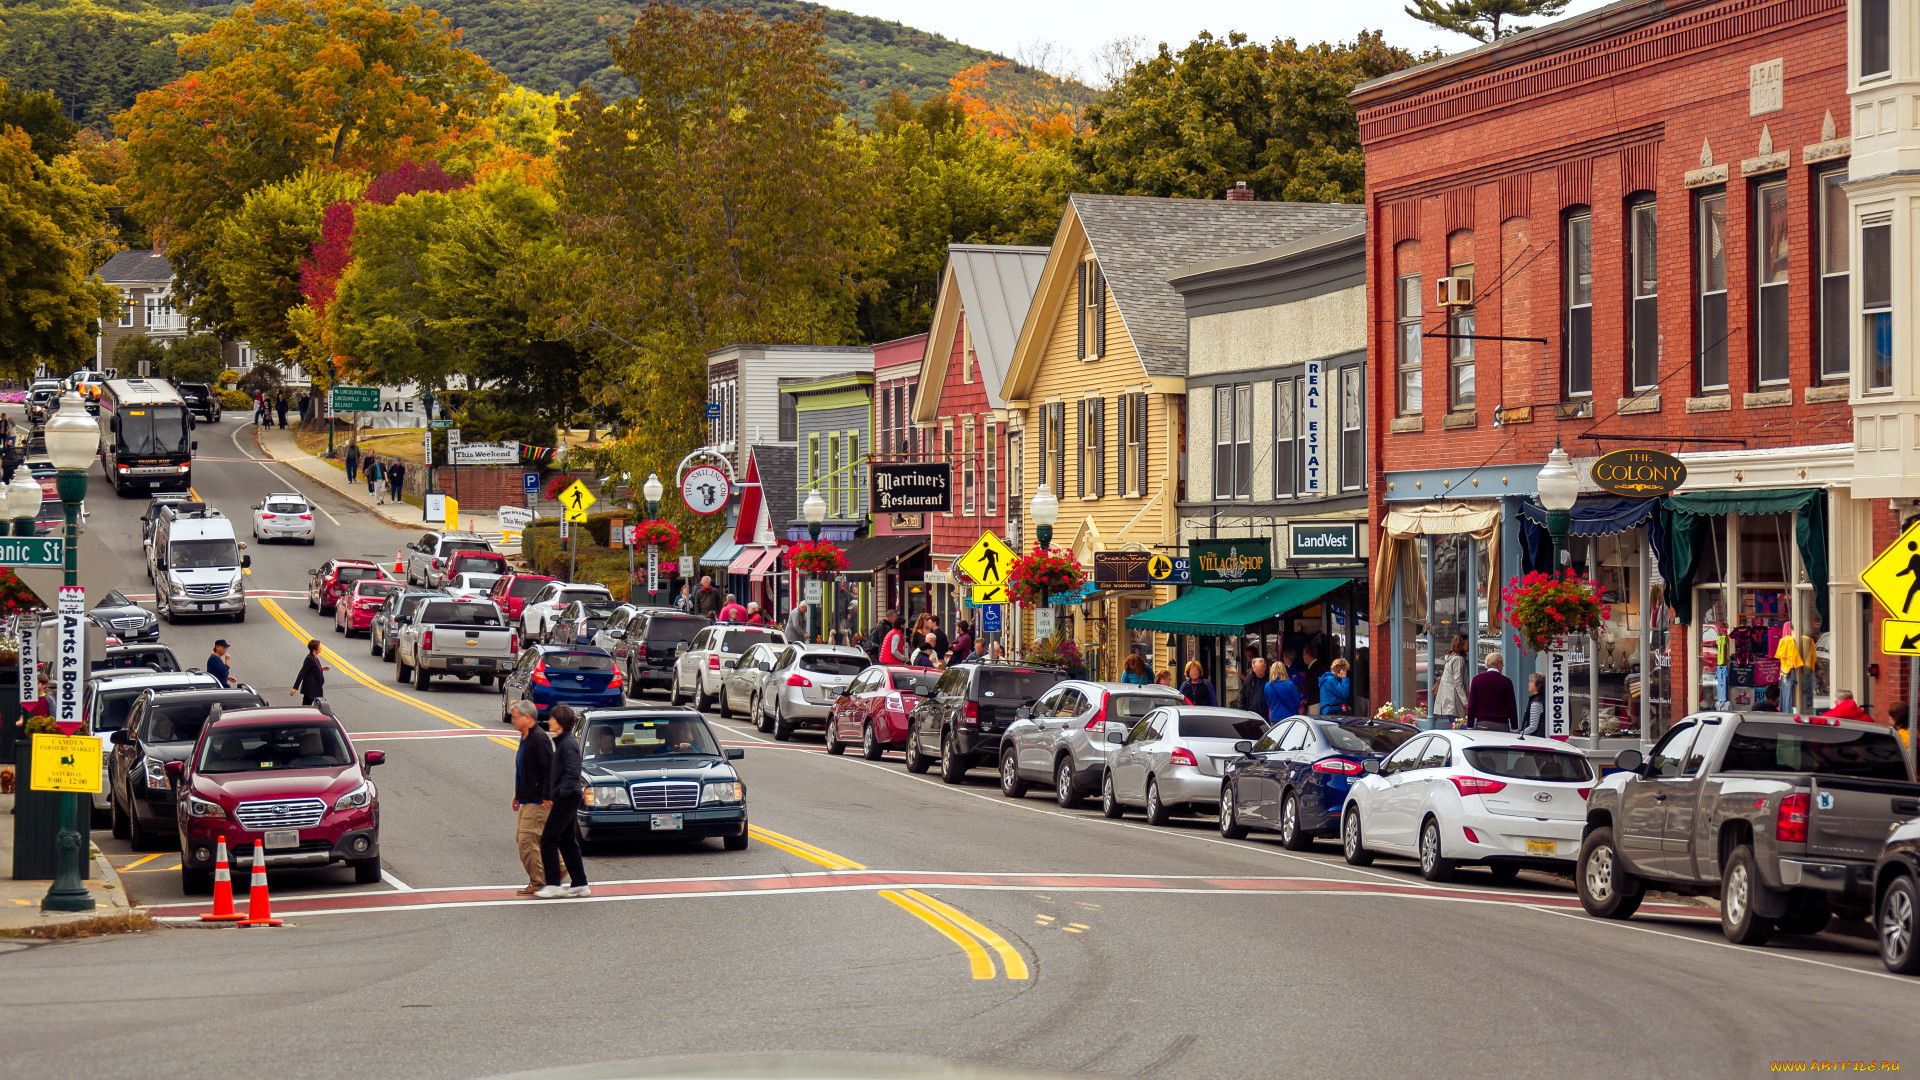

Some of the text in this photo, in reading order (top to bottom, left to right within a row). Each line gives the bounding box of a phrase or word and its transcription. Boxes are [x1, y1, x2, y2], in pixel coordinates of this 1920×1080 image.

[1308, 363, 1320, 489] REAL ESTATE
[1627, 454, 1653, 462] THE
[692, 469, 723, 482] SMILING
[1597, 463, 1681, 481] COLONY
[527, 475, 537, 487] P
[875, 471, 946, 492] Marriner's
[880, 492, 944, 509] Restaurant
[1298, 533, 1347, 547] LandVest
[42, 541, 60, 562] St
[1198, 554, 1264, 571] VILLAGE SHOP
[22, 630, 33, 656] Arts
[63, 615, 77, 654] Arts
[23, 657, 32, 665] &
[63, 656, 77, 668] &
[1552, 653, 1564, 683] Arts
[23, 667, 34, 701] Books
[1552, 685, 1564, 694] &
[62, 671, 77, 720] Books
[1552, 696, 1564, 734] Books
[69, 777, 88, 785] 12:00
